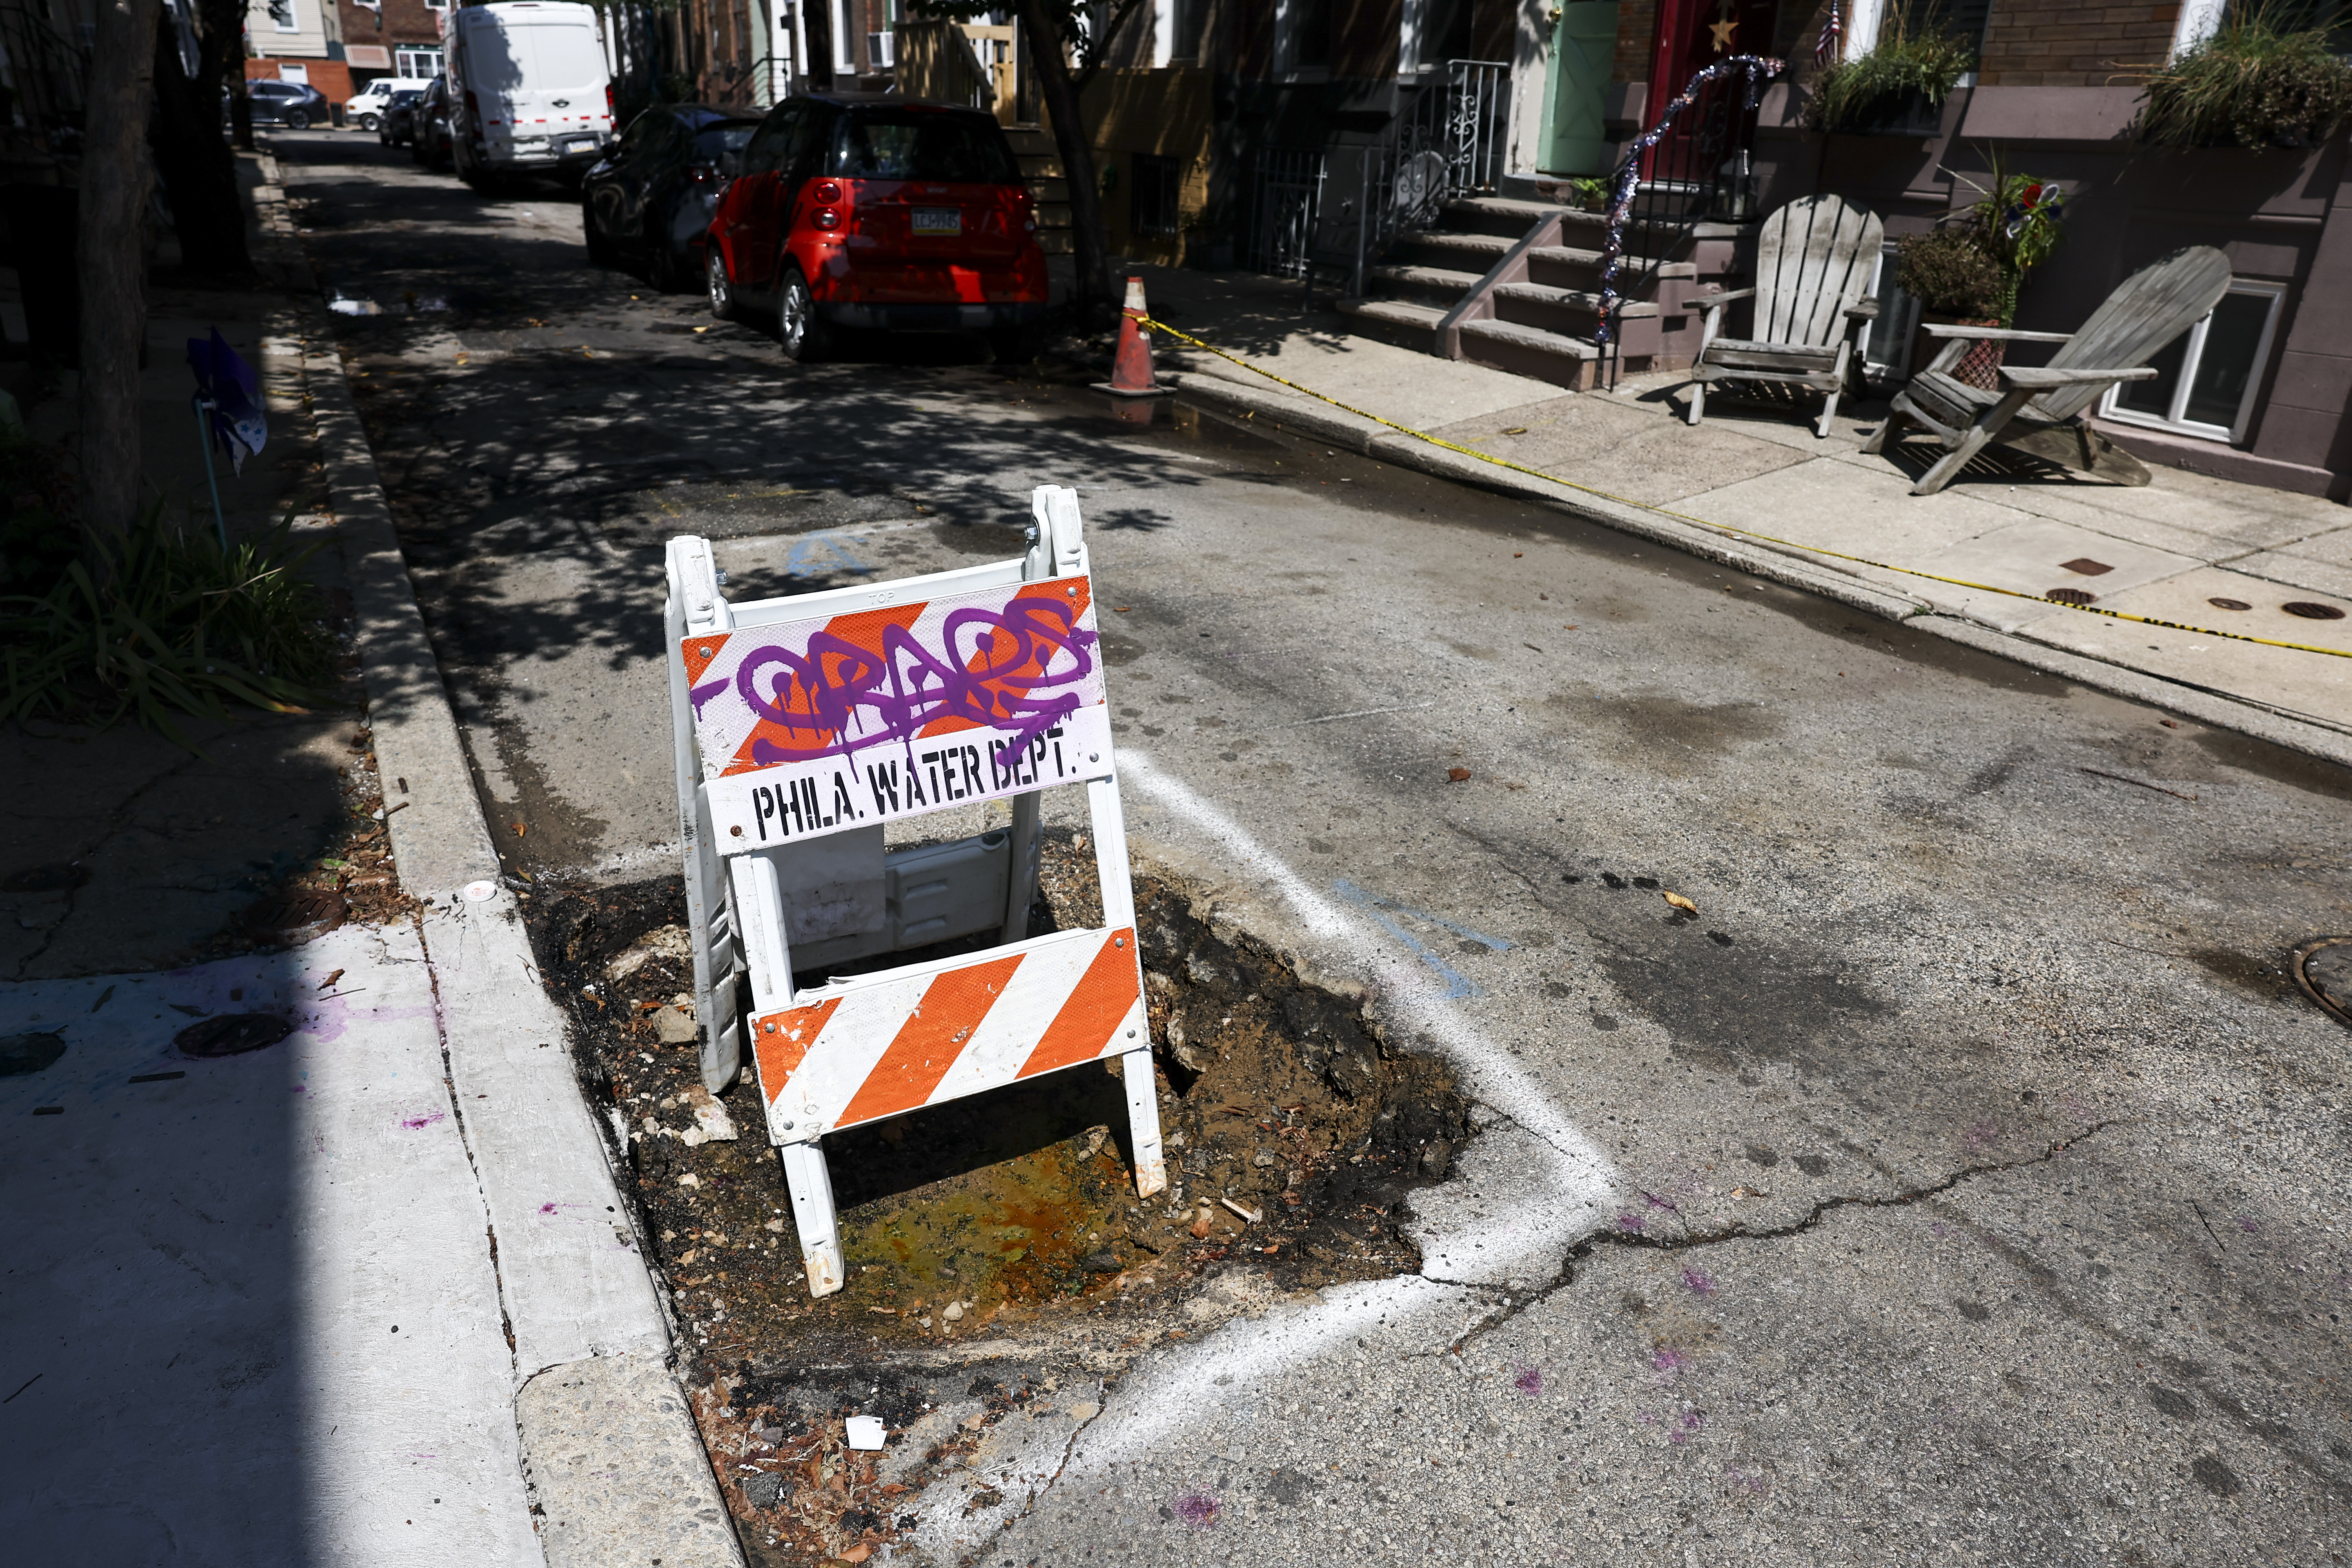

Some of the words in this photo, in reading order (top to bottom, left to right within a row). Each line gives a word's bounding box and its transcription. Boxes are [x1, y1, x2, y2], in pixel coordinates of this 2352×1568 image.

[869, 591, 895, 604] TOP
[753, 771, 864, 841] PHILA.
[867, 745, 985, 815] WATER
[988, 727, 1076, 790] DEPT.
